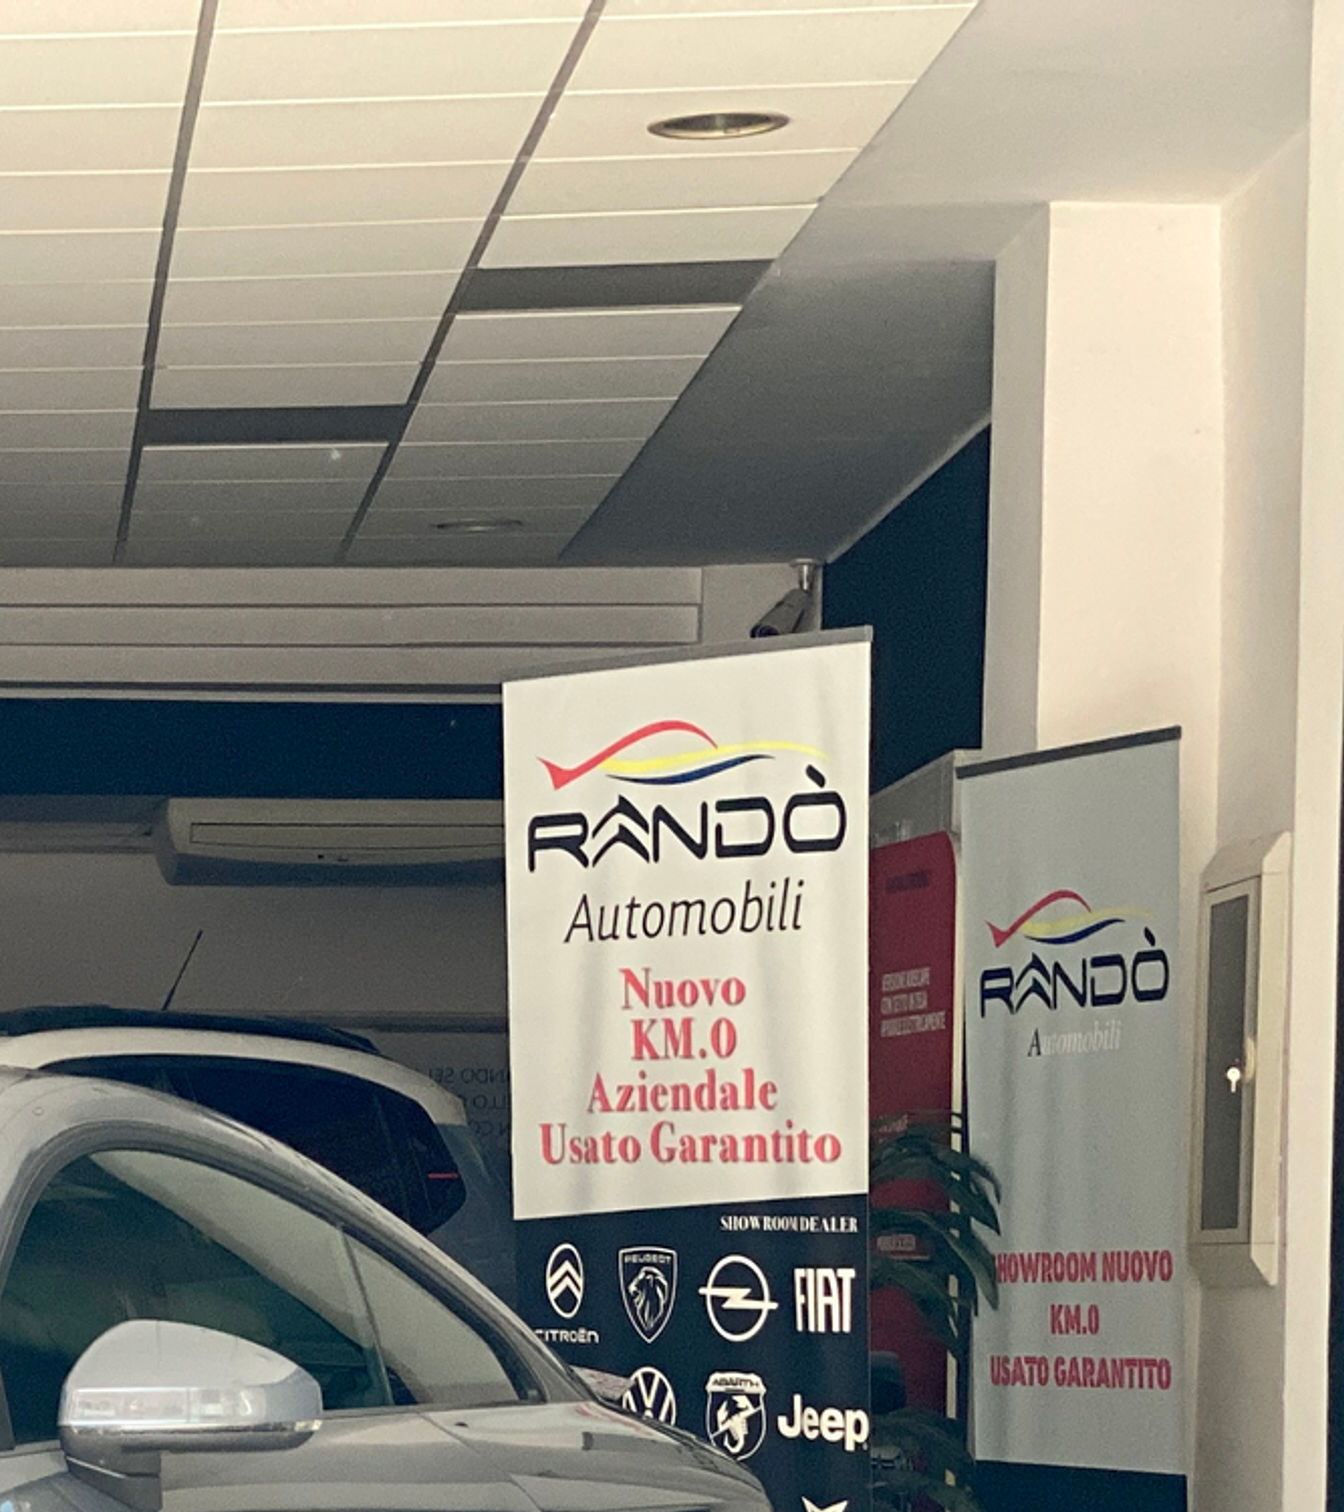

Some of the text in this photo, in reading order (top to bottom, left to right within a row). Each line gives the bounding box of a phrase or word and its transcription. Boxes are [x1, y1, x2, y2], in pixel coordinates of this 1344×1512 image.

[528, 764, 847, 873] RANDÒ
[564, 878, 806, 944] Automobili
[618, 967, 746, 1010] Nuovo
[980, 926, 1170, 1019] RANDÒ
[587, 1068, 778, 1114] Aziendale
[539, 1123, 642, 1165] Usato
[650, 1119, 843, 1164] Garantito
[997, 1249, 1173, 1283] HOWROOM NUOVO
[794, 1268, 856, 1333] FIAT
[990, 1355, 1171, 1390] USATO GARANTITO
[777, 1394, 870, 1451] Jeep
